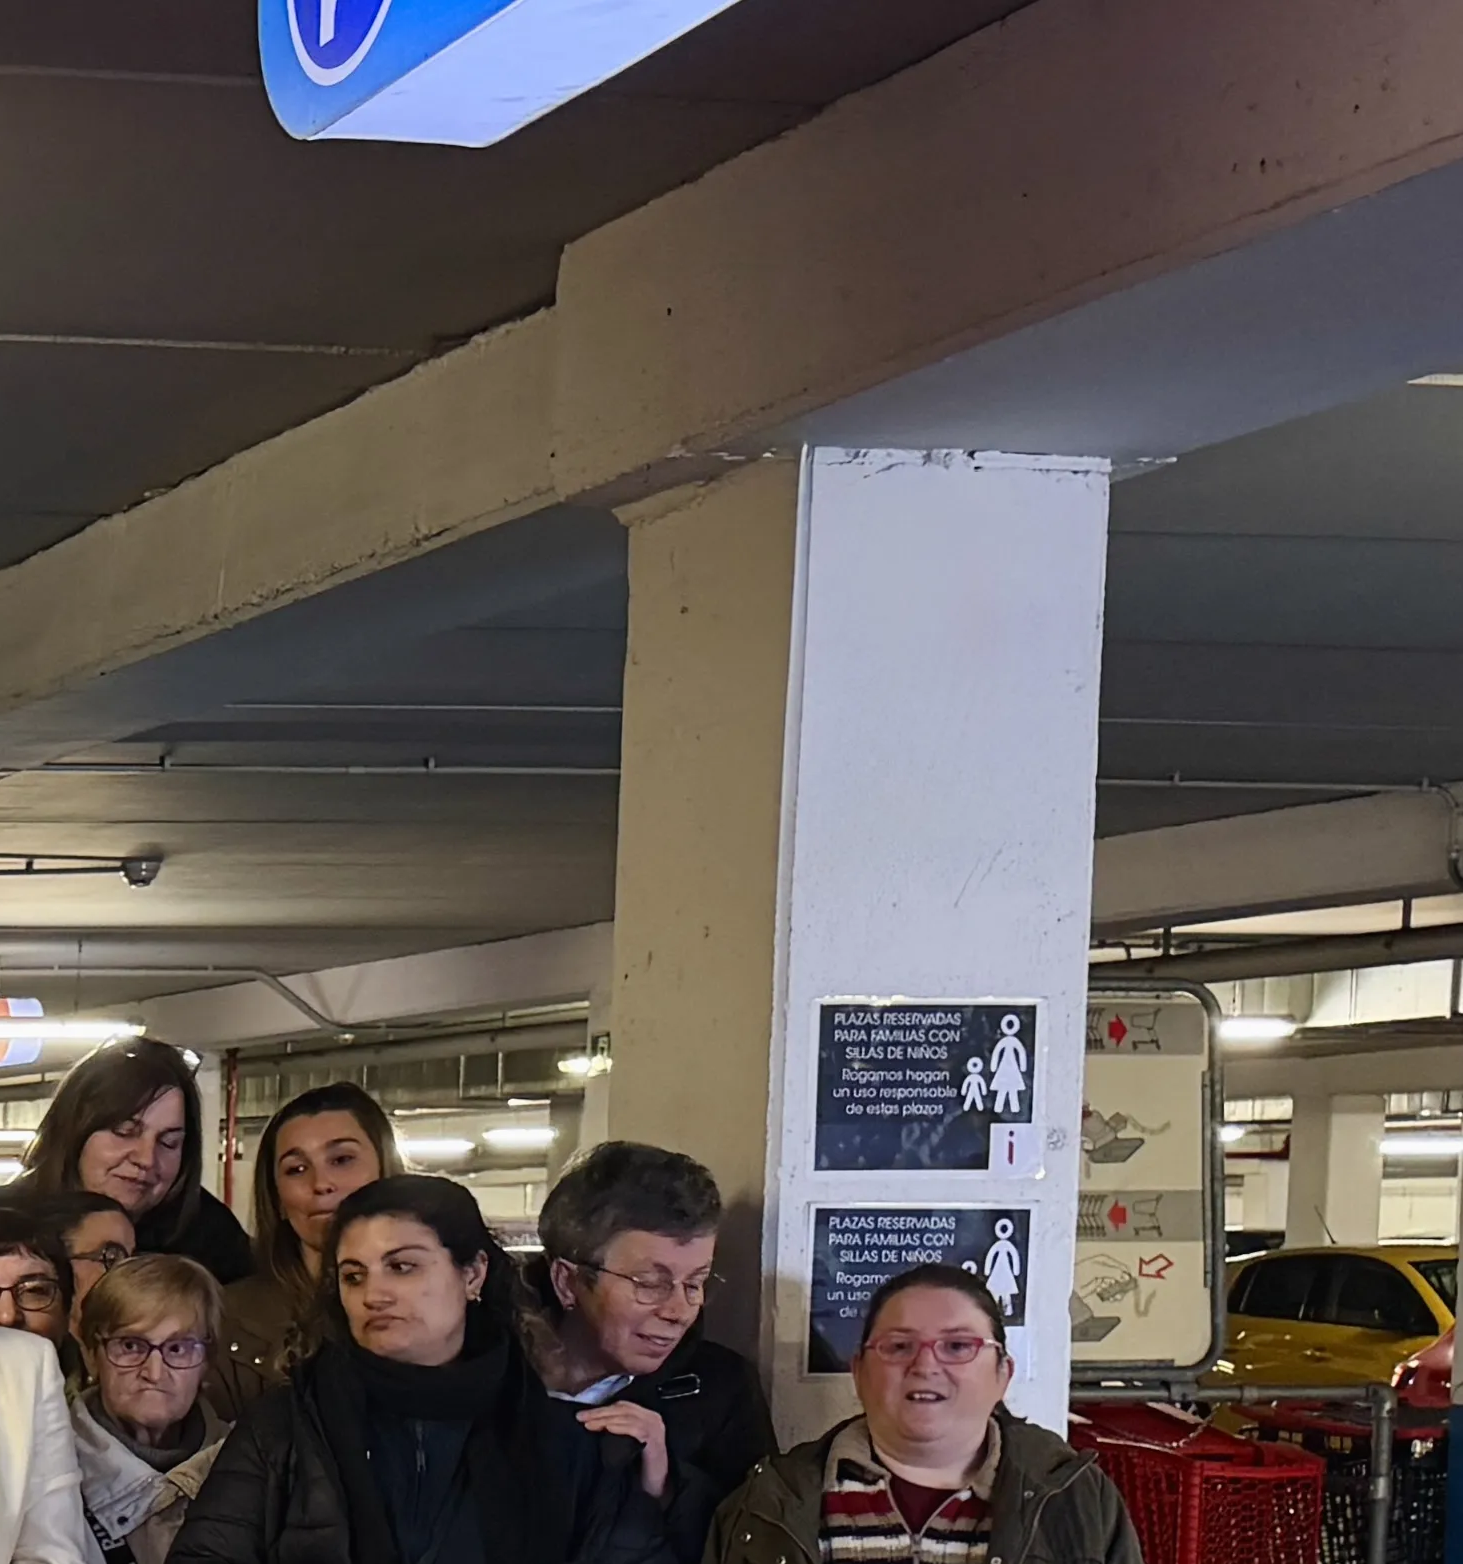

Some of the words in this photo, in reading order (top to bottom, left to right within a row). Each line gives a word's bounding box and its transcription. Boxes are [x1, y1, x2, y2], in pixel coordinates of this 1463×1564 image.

[834, 1012, 881, 1026] PLAZAS
[883, 1012, 962, 1026] RESERVADAS
[834, 1029, 867, 1042] PARA
[871, 1029, 926, 1042] FAMILIAS
[928, 1029, 961, 1042] CON
[845, 1046, 884, 1060] SILLAS
[887, 1046, 904, 1060] DE
[907, 1044, 949, 1060] NIÑOS
[842, 1067, 904, 1085] Rogamos
[833, 1087, 851, 1099] un
[854, 1087, 877, 1099] uso
[879, 1086, 958, 1102] responsable
[846, 1103, 863, 1115] de
[866, 1103, 900, 1116] estas
[902, 1103, 944, 1118] plazas
[828, 1216, 875, 1230] PLAZAS
[877, 1216, 956, 1230] RESERVADAS
[828, 1233, 862, 1246] PARA
[865, 1233, 920, 1246] FAMILIAS
[923, 1233, 955, 1246] CON
[839, 1250, 879, 1263] SILLAS
[881, 1250, 899, 1263] DE
[901, 1247, 943, 1263] NIÑOS
[827, 1290, 845, 1301] un
[847, 1290, 871, 1301] uso
[839, 1306, 857, 1319] de
